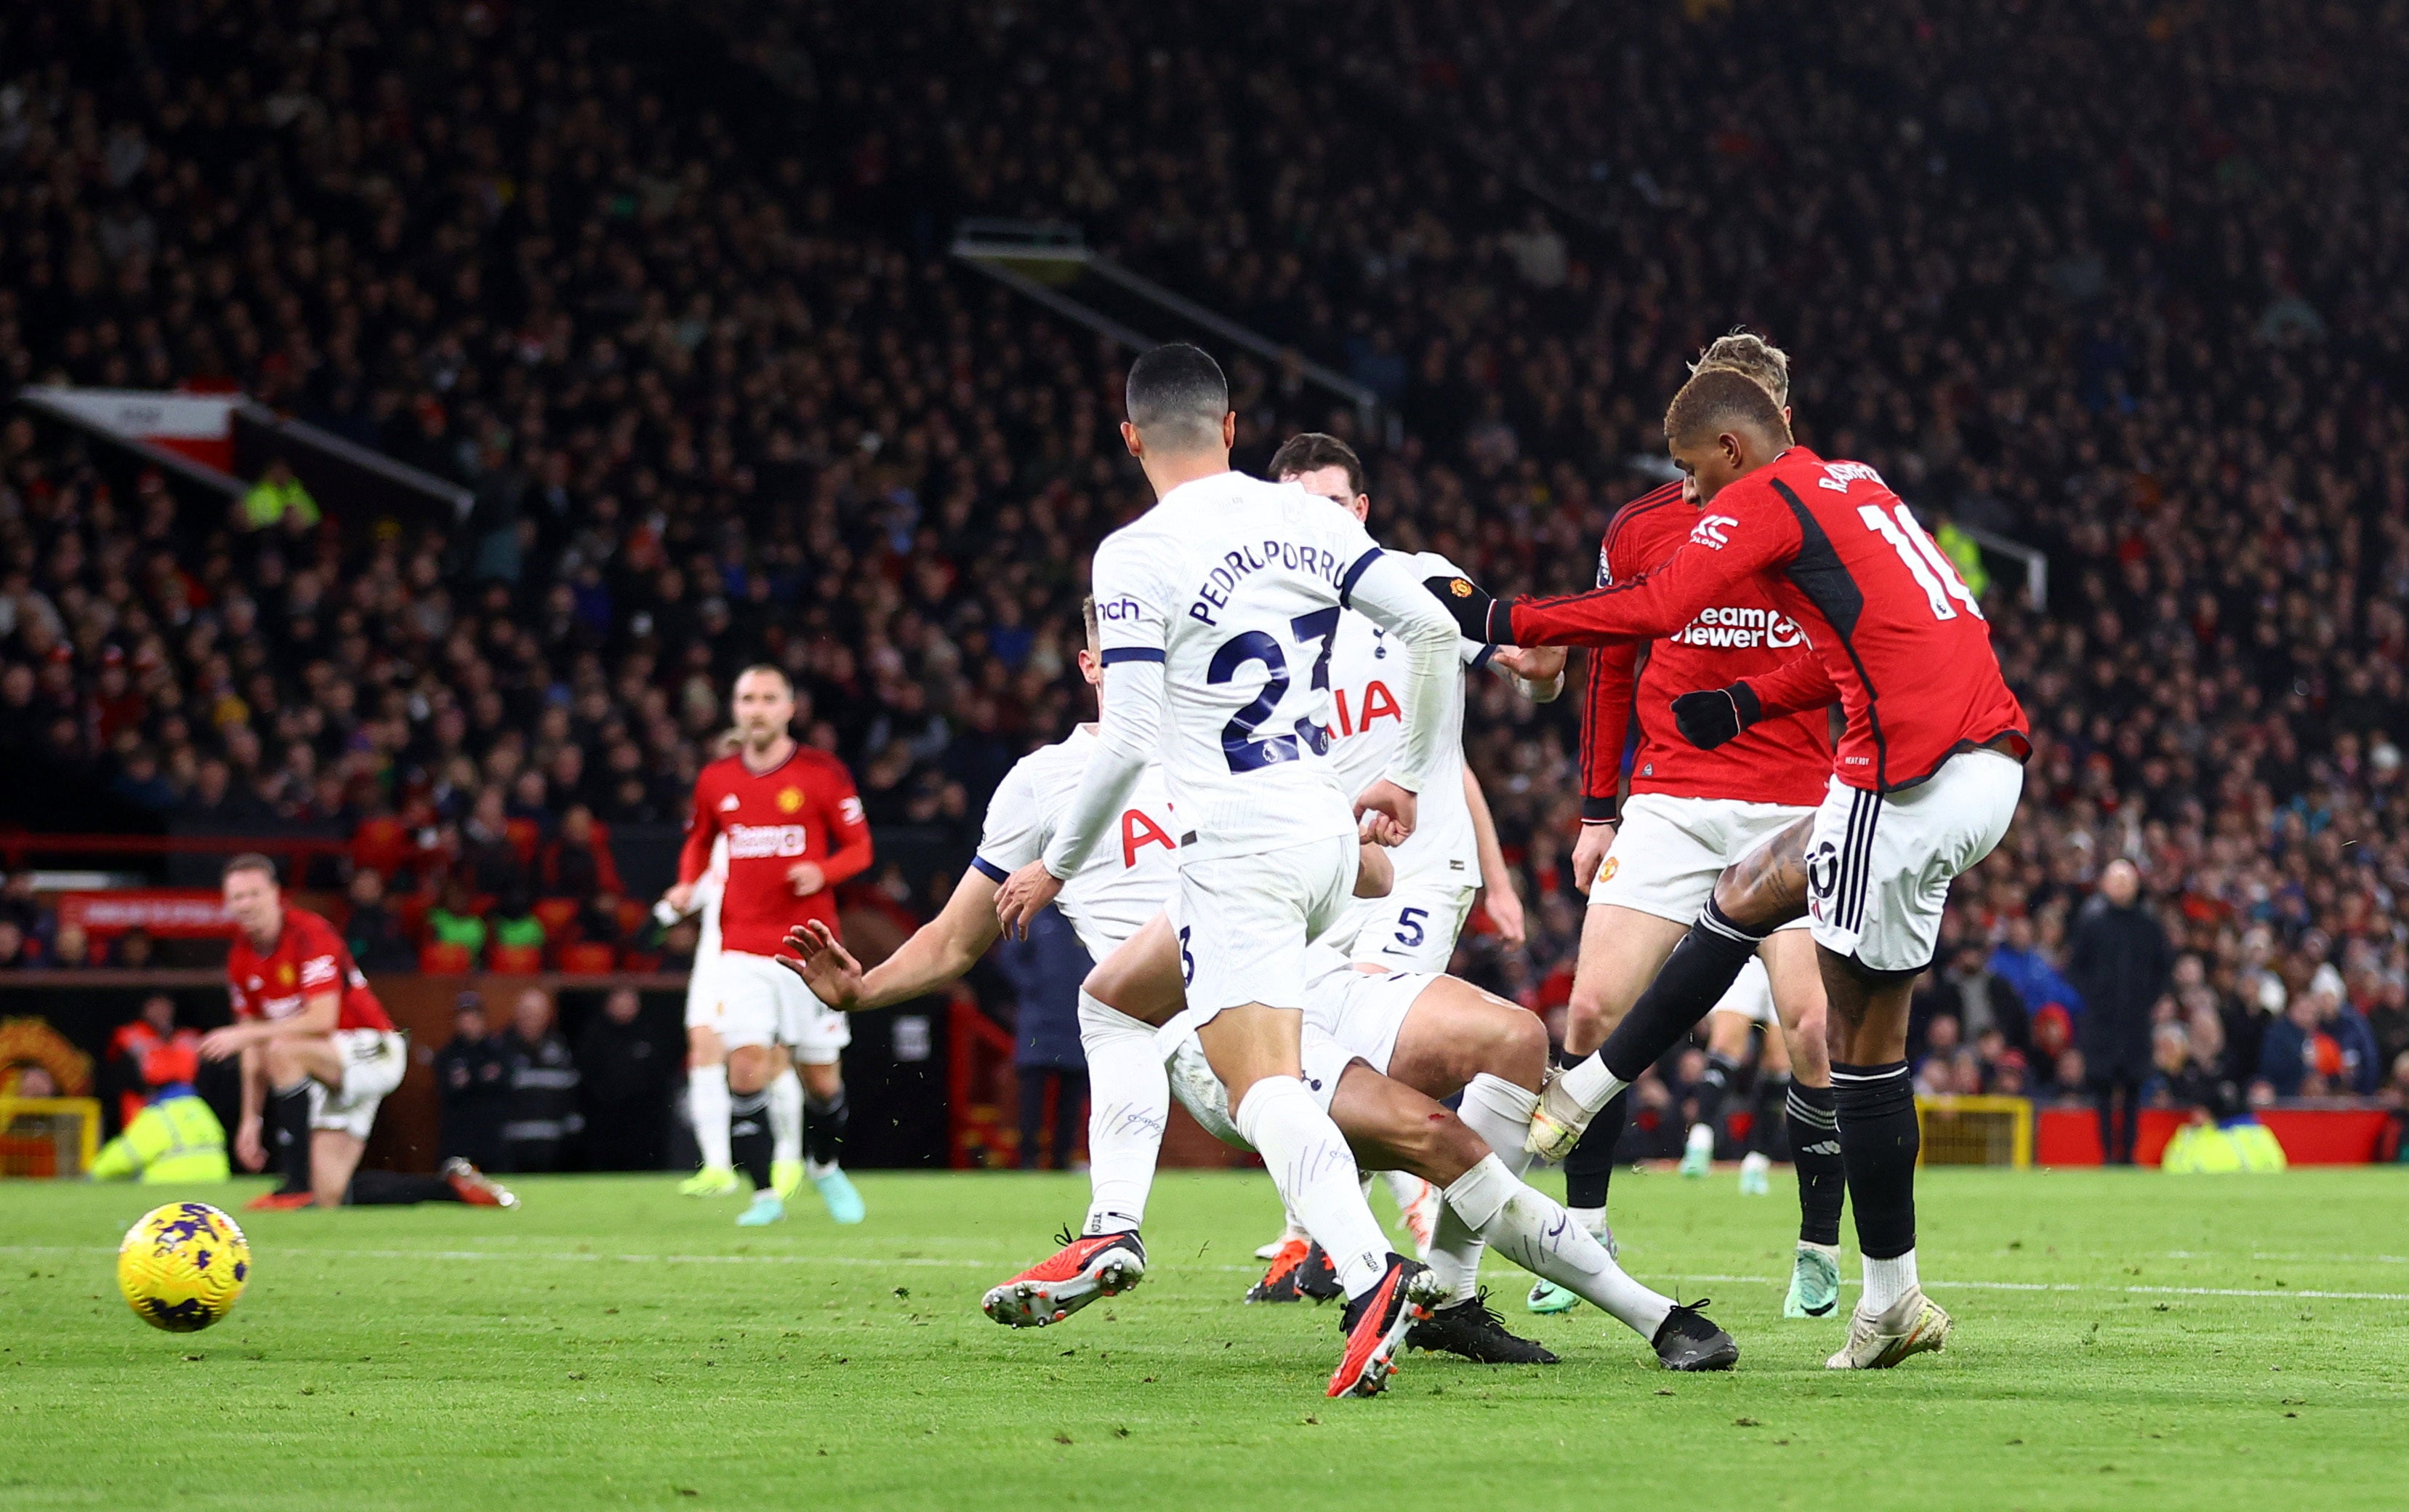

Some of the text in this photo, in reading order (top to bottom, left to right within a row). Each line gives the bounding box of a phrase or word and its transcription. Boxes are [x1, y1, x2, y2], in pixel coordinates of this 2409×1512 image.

[1692, 607, 1766, 628] eam
[1326, 680, 1401, 741] IA
[1394, 906, 1429, 946] 5
